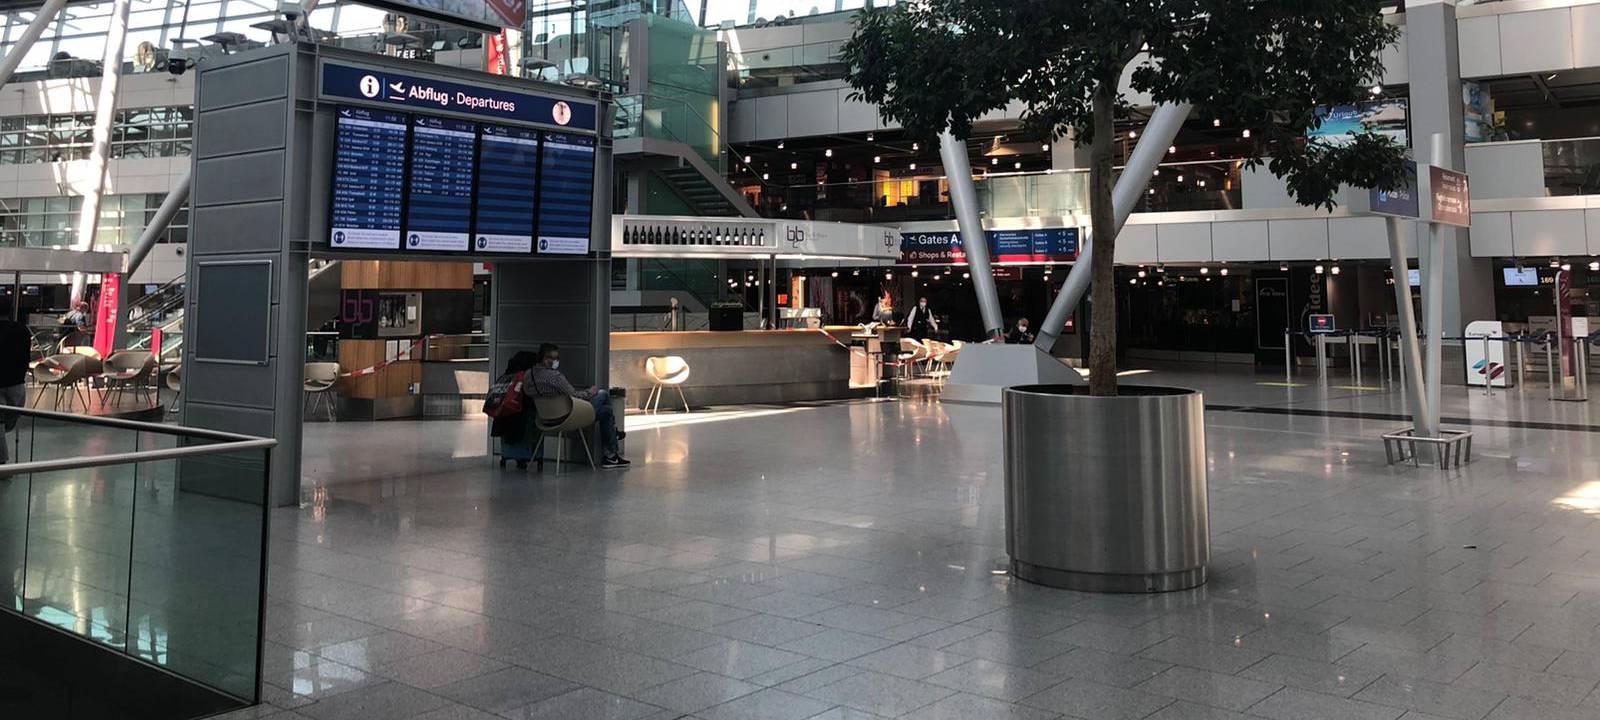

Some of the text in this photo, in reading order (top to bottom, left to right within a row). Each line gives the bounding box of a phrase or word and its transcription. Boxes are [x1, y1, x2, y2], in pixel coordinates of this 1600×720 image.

[408, 86, 516, 112] Abflug Departures
[918, 234, 948, 245] Gates
[918, 251, 940, 259] Shops
